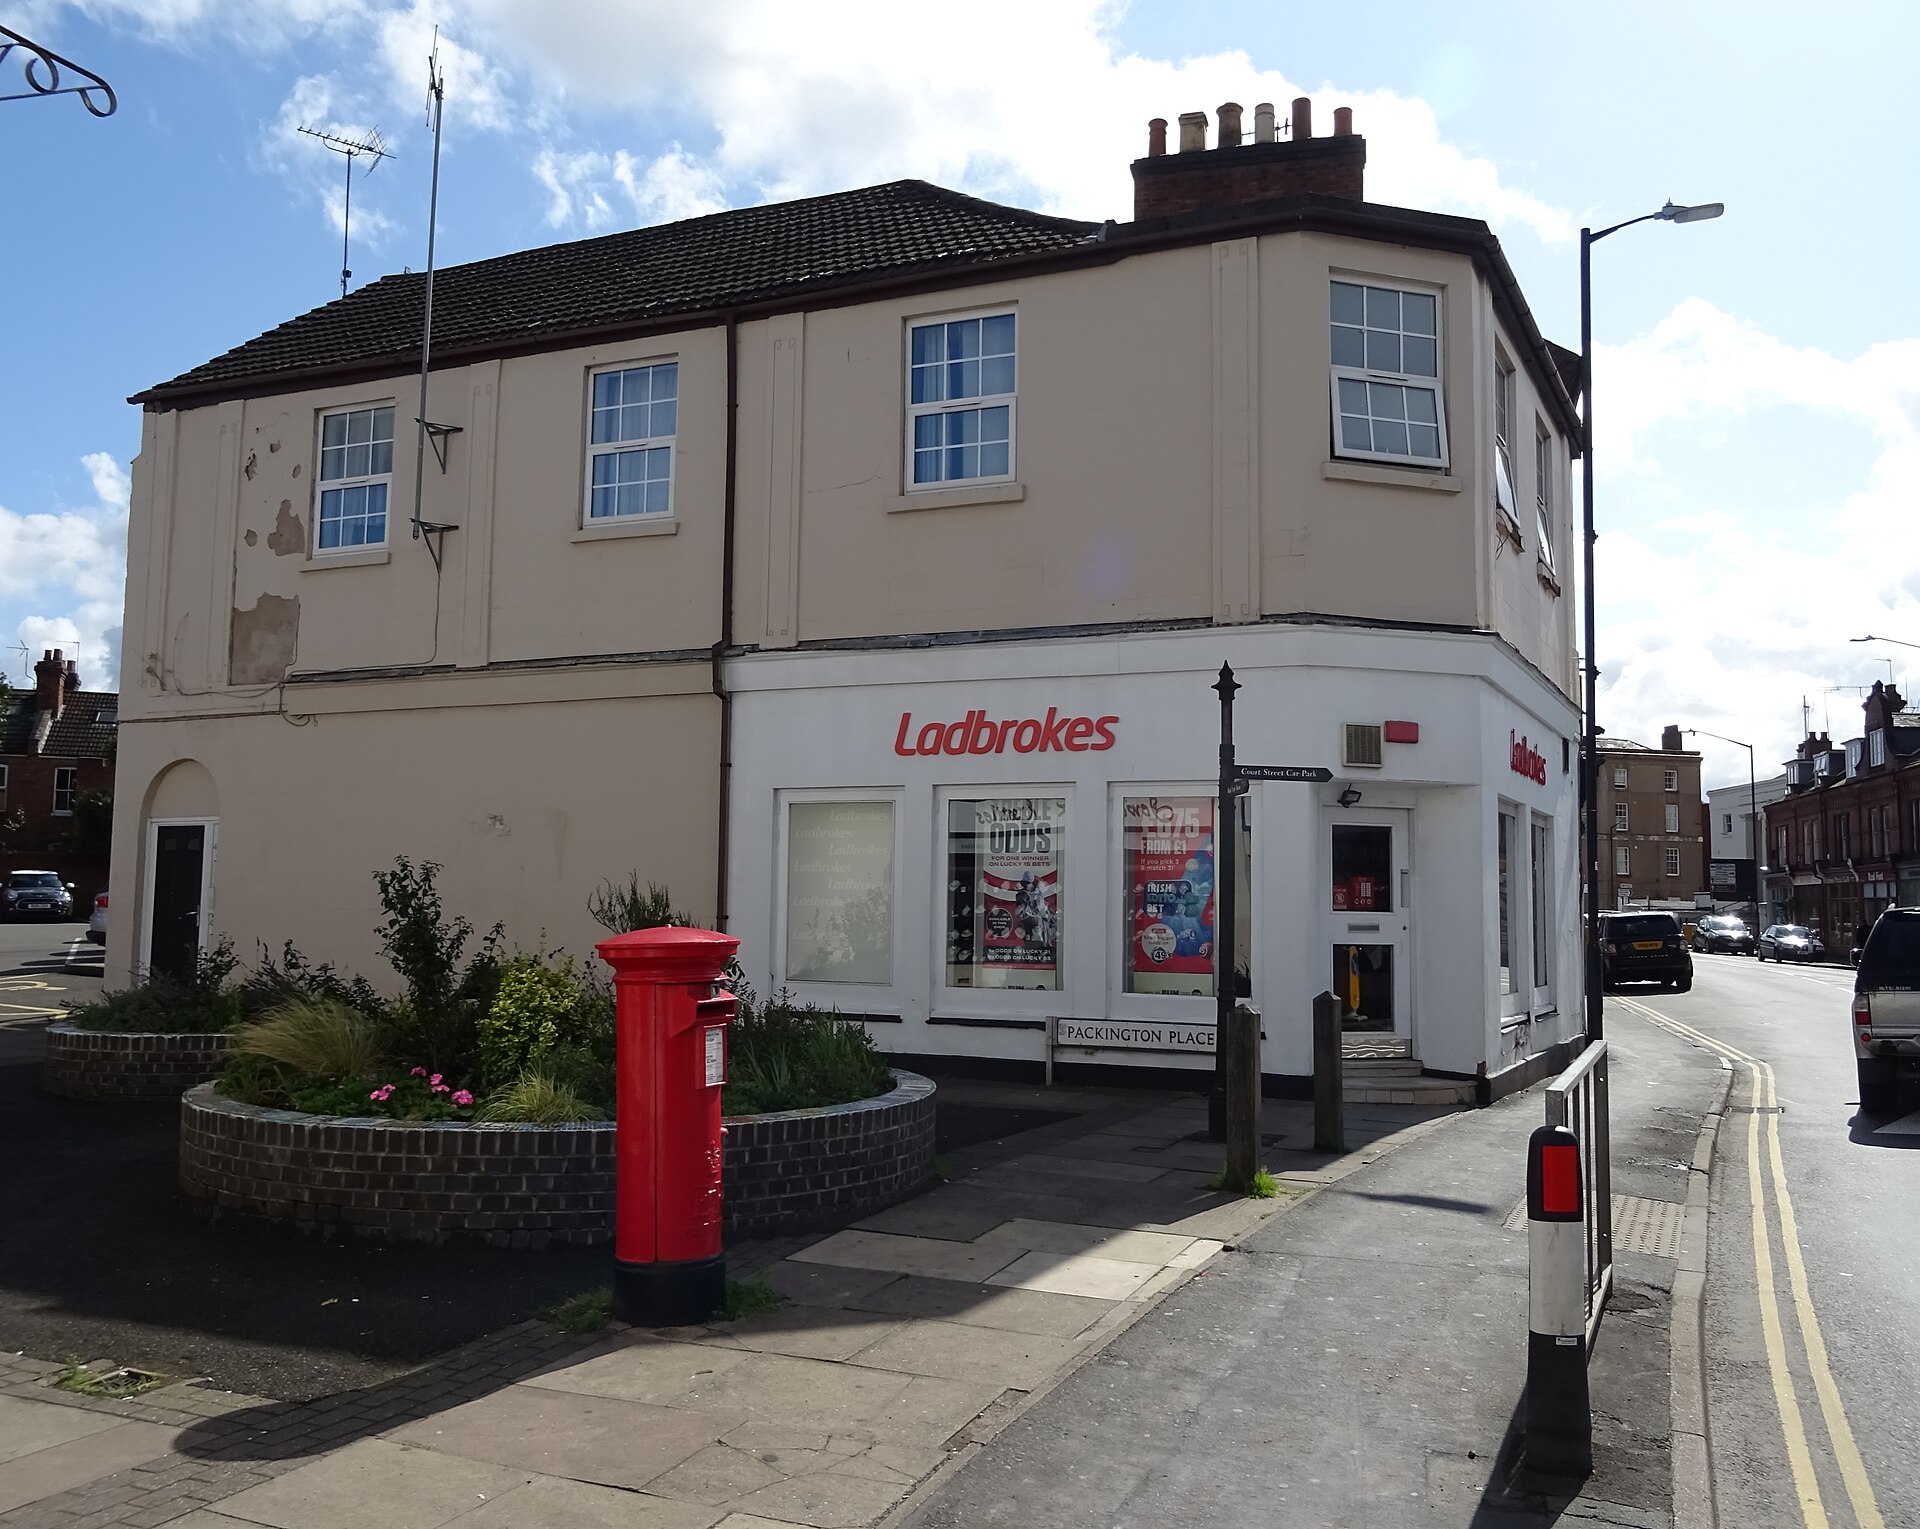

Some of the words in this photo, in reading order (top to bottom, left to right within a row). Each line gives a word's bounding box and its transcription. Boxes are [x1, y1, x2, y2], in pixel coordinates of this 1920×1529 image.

[894, 706, 1119, 756] Ladbrokes
[1240, 767, 1261, 776] Court
[1263, 768, 1284, 777] Street
[1286, 769, 1300, 777] Car
[1301, 769, 1317, 778] Park
[990, 822, 1051, 854] ODDS
[1140, 839, 1171, 855] FROM
[1173, 839, 1187, 855] £1
[1159, 858, 1174, 866] pick
[1147, 882, 1172, 893] IRISH
[1146, 903, 1165, 913] BET
[1067, 1026, 1163, 1043] PACKINGTON
[1168, 1031, 1215, 1046] PLACE
